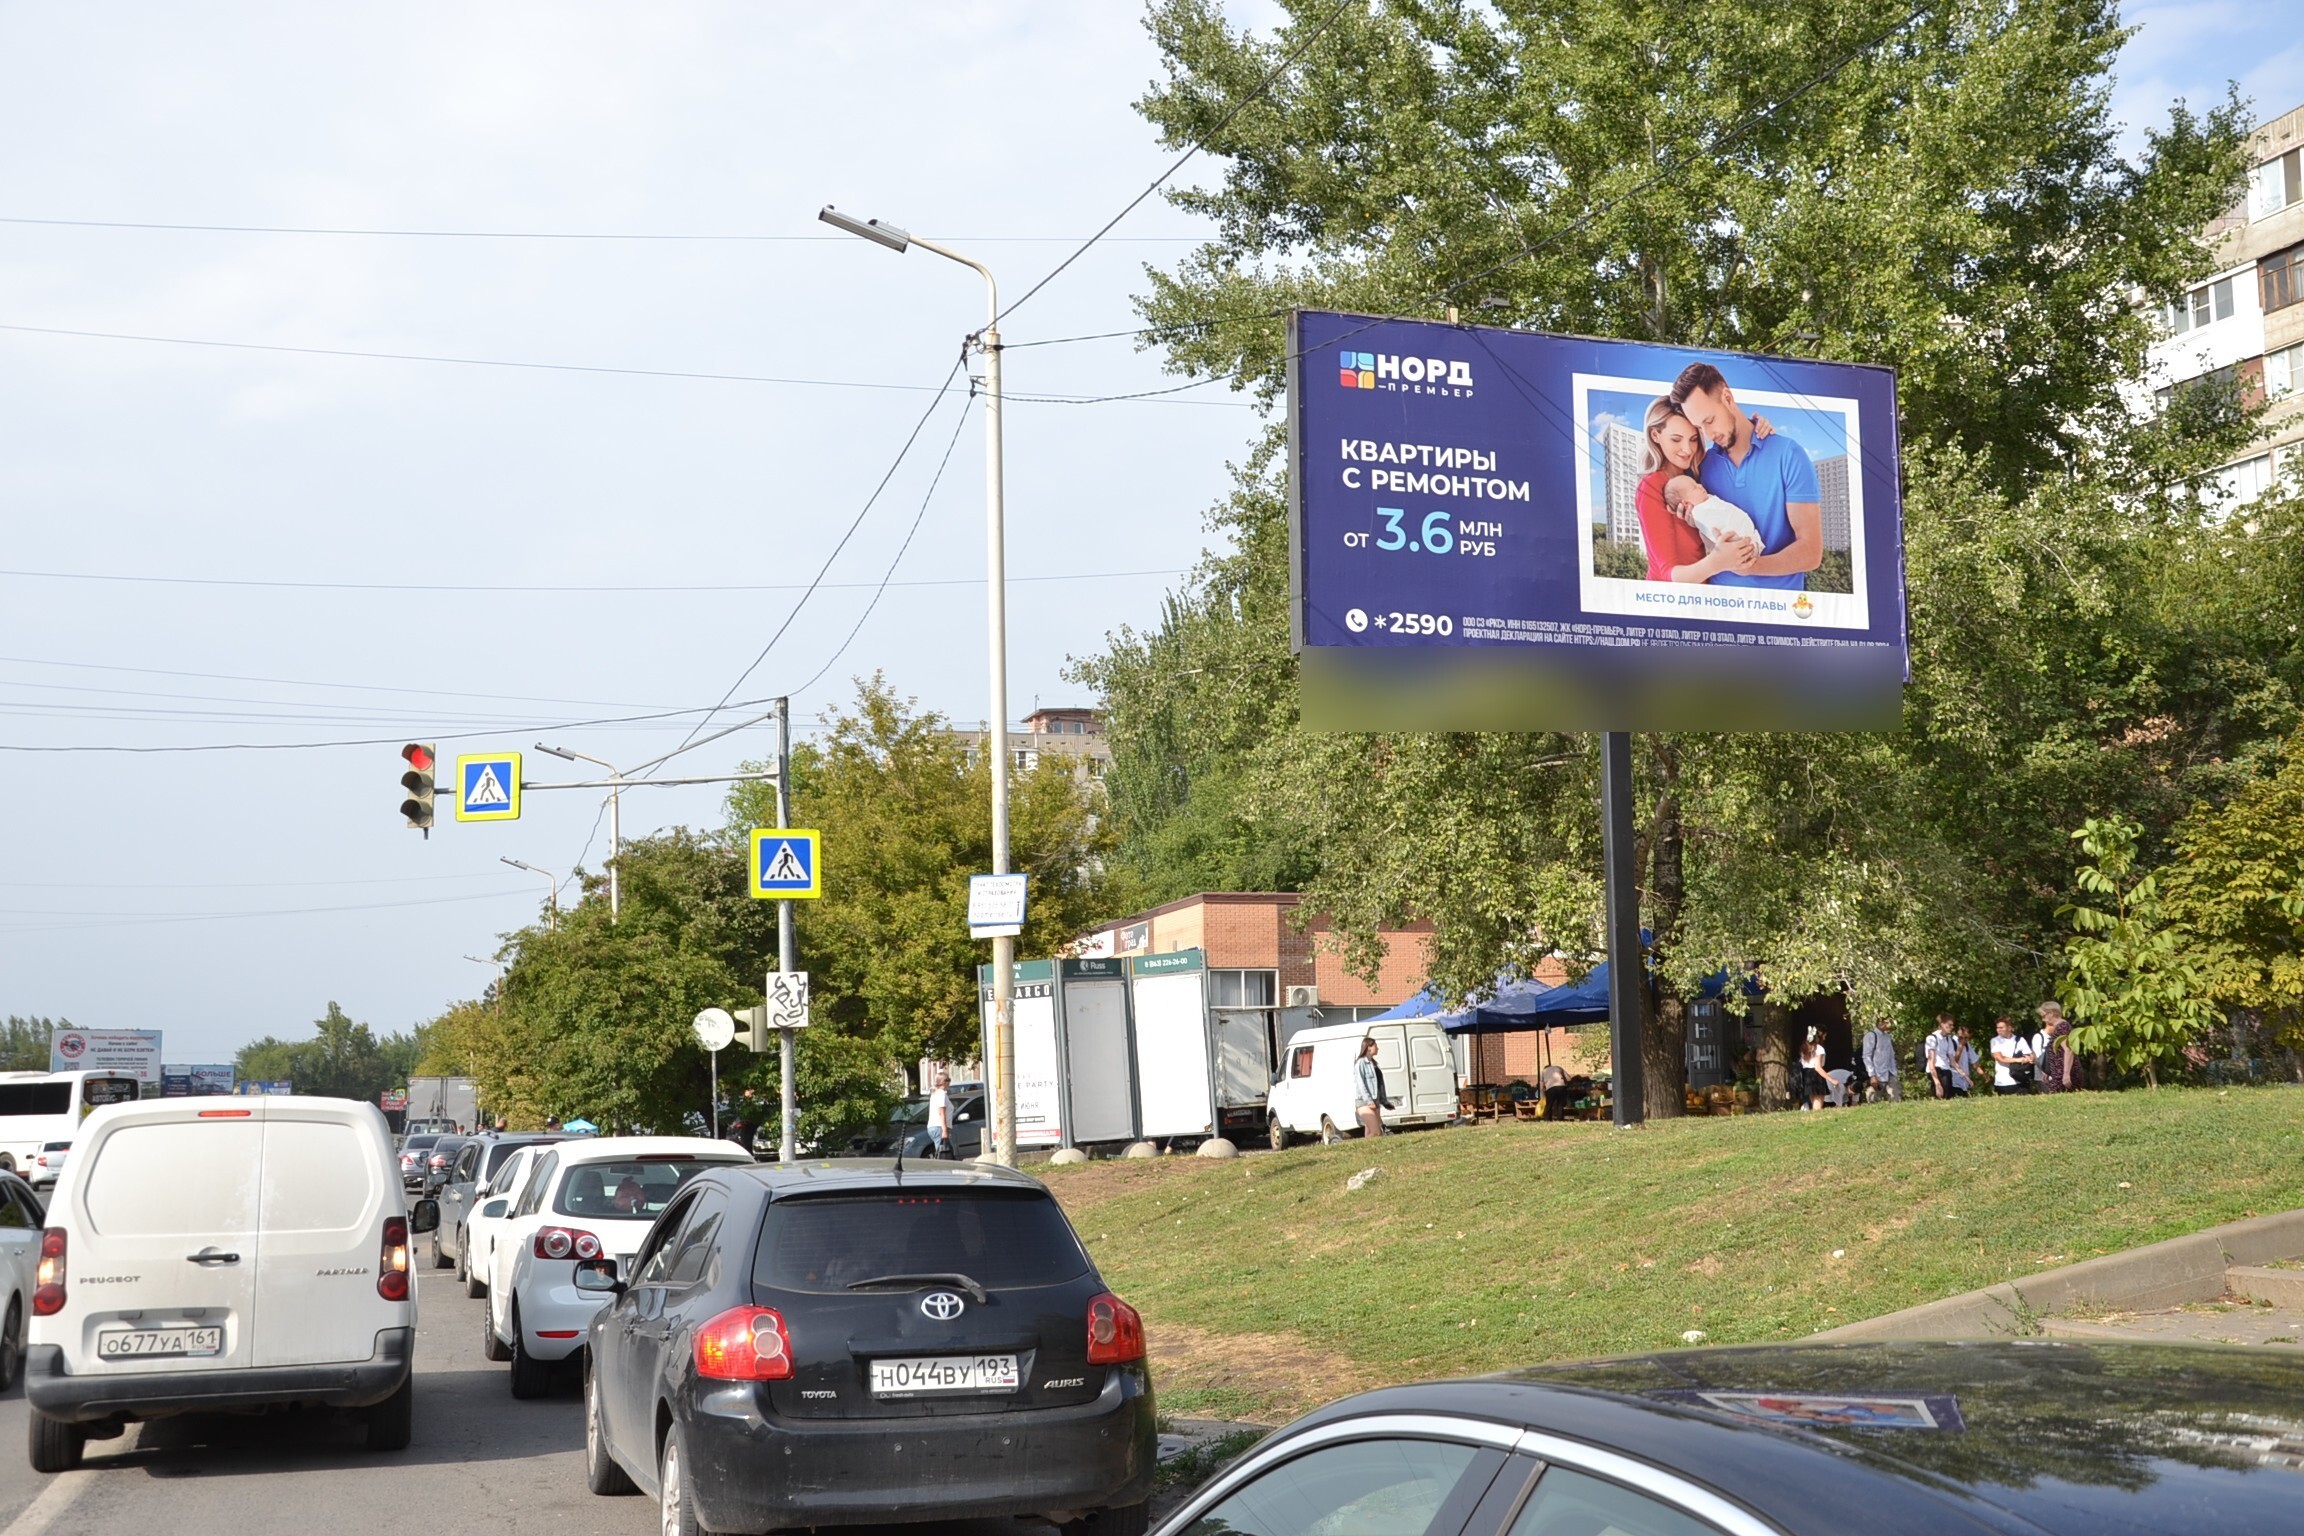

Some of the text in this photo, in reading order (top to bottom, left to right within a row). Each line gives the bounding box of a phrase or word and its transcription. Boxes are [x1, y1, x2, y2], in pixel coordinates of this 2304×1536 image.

[1377, 354, 1473, 386] НОРД
[1341, 438, 1496, 471] КВАРТИРЫ
[1342, 467, 1530, 502] С РЕМОНТОМ
[1344, 507, 1454, 554] ОТ 3.6
[1459, 520, 1502, 537] МЛН
[1460, 540, 1496, 557] РУБ
[1635, 592, 1787, 611] МЕСТО ДЛЯ НОВОЙ ГЛАВЫ
[1463, 617, 1475, 627] ООО
[1476, 618, 1485, 628] СЗ
[1507, 619, 1521, 630] ИНН
[1560, 622, 1571, 633] ЖК
[1626, 627, 1646, 637] ЛИТЕР
[1647, 628, 1654, 638] 17
[1681, 630, 1701, 640] ЛИТЕР
[1737, 634, 1756, 644] ЛИТЕР
[1766, 636, 1800, 646] СТОИМОСТЬ
[1463, 628, 1500, 640] ПРОЕКТНАЯ
[1501, 630, 1543, 642] ДЕКЛАРАЦИЯ
[1544, 632, 1553, 643] НА
[1554, 633, 1573, 644] САЙТЕ
[1090, 961, 1106, 970] Russ
[987, 984, 1050, 1001] EARGO
[1026, 1080, 1054, 1088] PARTY
[79, 1275, 141, 1285] PEUGEOT
[316, 1267, 370, 1277] PARTNER
[106, 1330, 215, 1353] О677УА 161
[881, 1357, 1010, 1388] Н044ВУ 193
[985, 1376, 1002, 1384] RUS
[1043, 1377, 1085, 1390] AURIS
[801, 1390, 837, 1399] TOYOTA
